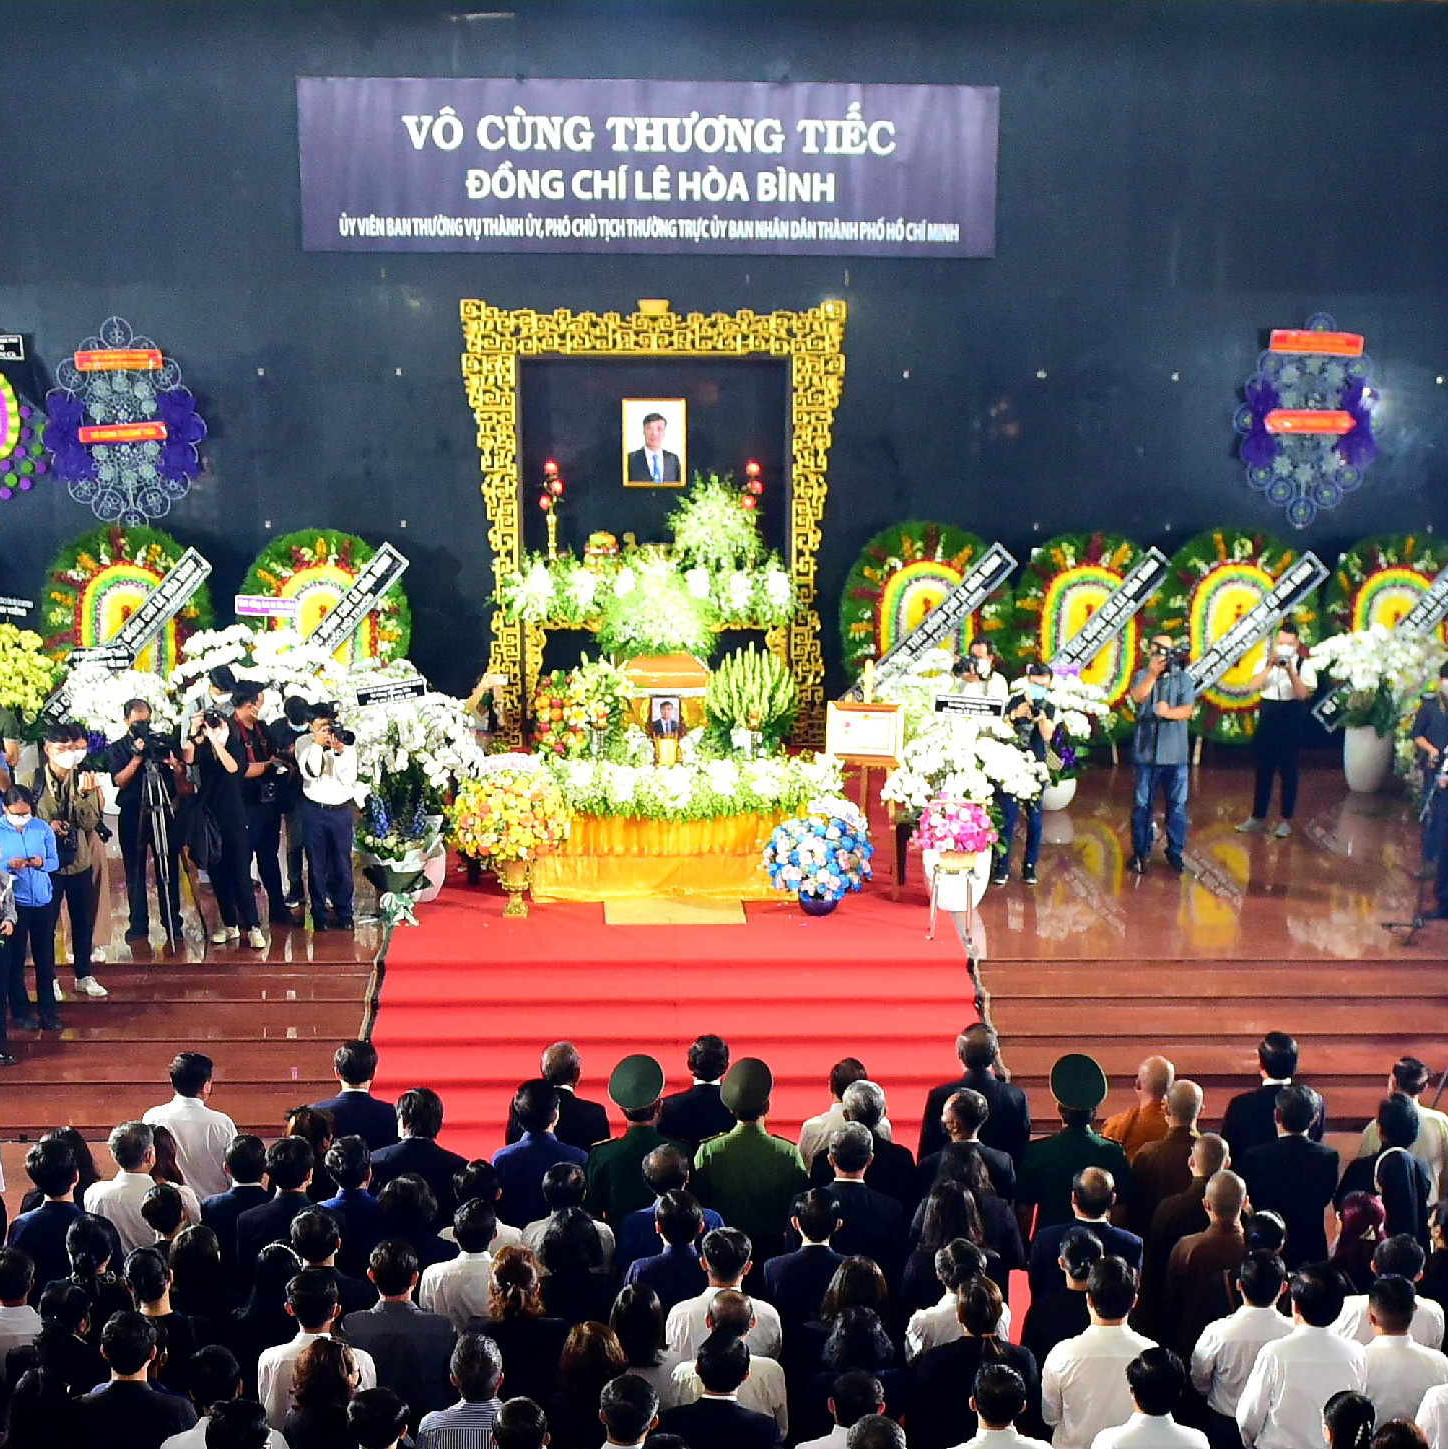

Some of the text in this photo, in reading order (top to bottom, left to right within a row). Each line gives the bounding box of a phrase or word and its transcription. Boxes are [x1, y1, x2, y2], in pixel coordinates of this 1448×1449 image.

[401, 101, 897, 154] VÔ CÙNG THƯƠNG TIẾC
[466, 161, 835, 202] ĐỒNG CHÍ LÊ HÒA BÌNH
[339, 213, 960, 242] ỦY VIÊN BAN THƯỜNG VỤ THÀNH ỦY, PHÓ CHỦ TỊCH THƯỜNG TRỰC ỦY BAN NHÂN DÂN THÀNH PHỐ HỒ CHÍ MINH
